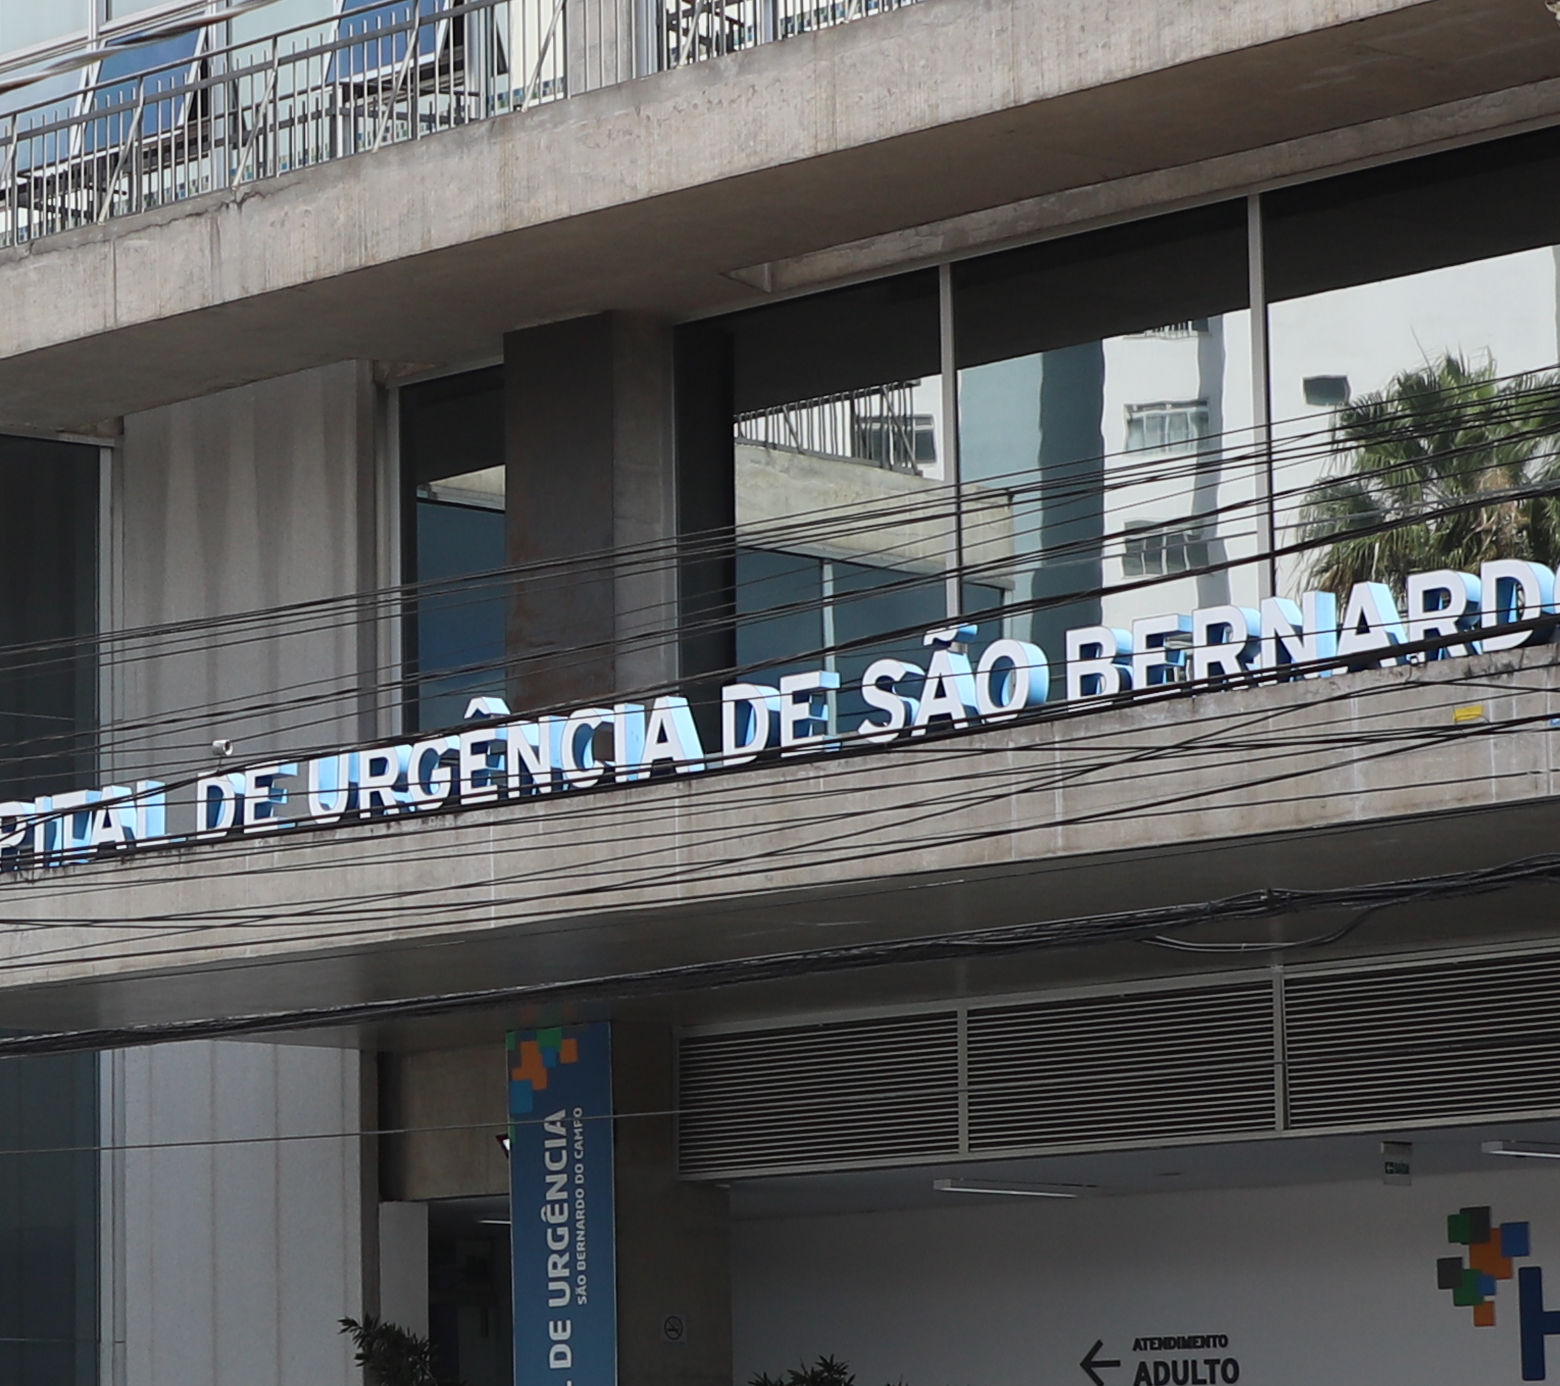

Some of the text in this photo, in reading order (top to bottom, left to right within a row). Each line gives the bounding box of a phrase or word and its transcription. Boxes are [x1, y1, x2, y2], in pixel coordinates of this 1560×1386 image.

[196, 760, 298, 840] DE
[307, 696, 706, 824] URGÊNCIA
[722, 671, 841, 766] DE
[858, 623, 1049, 744] SÃO
[540, 1108, 572, 1308] URGÊNCIA
[573, 1107, 587, 1304] SÃO BERNARDO DO CAMPO
[548, 1319, 573, 1369] DE
[1132, 1334, 1228, 1351] ATENDIMENTO
[1133, 1358, 1240, 1386] ADULTO
